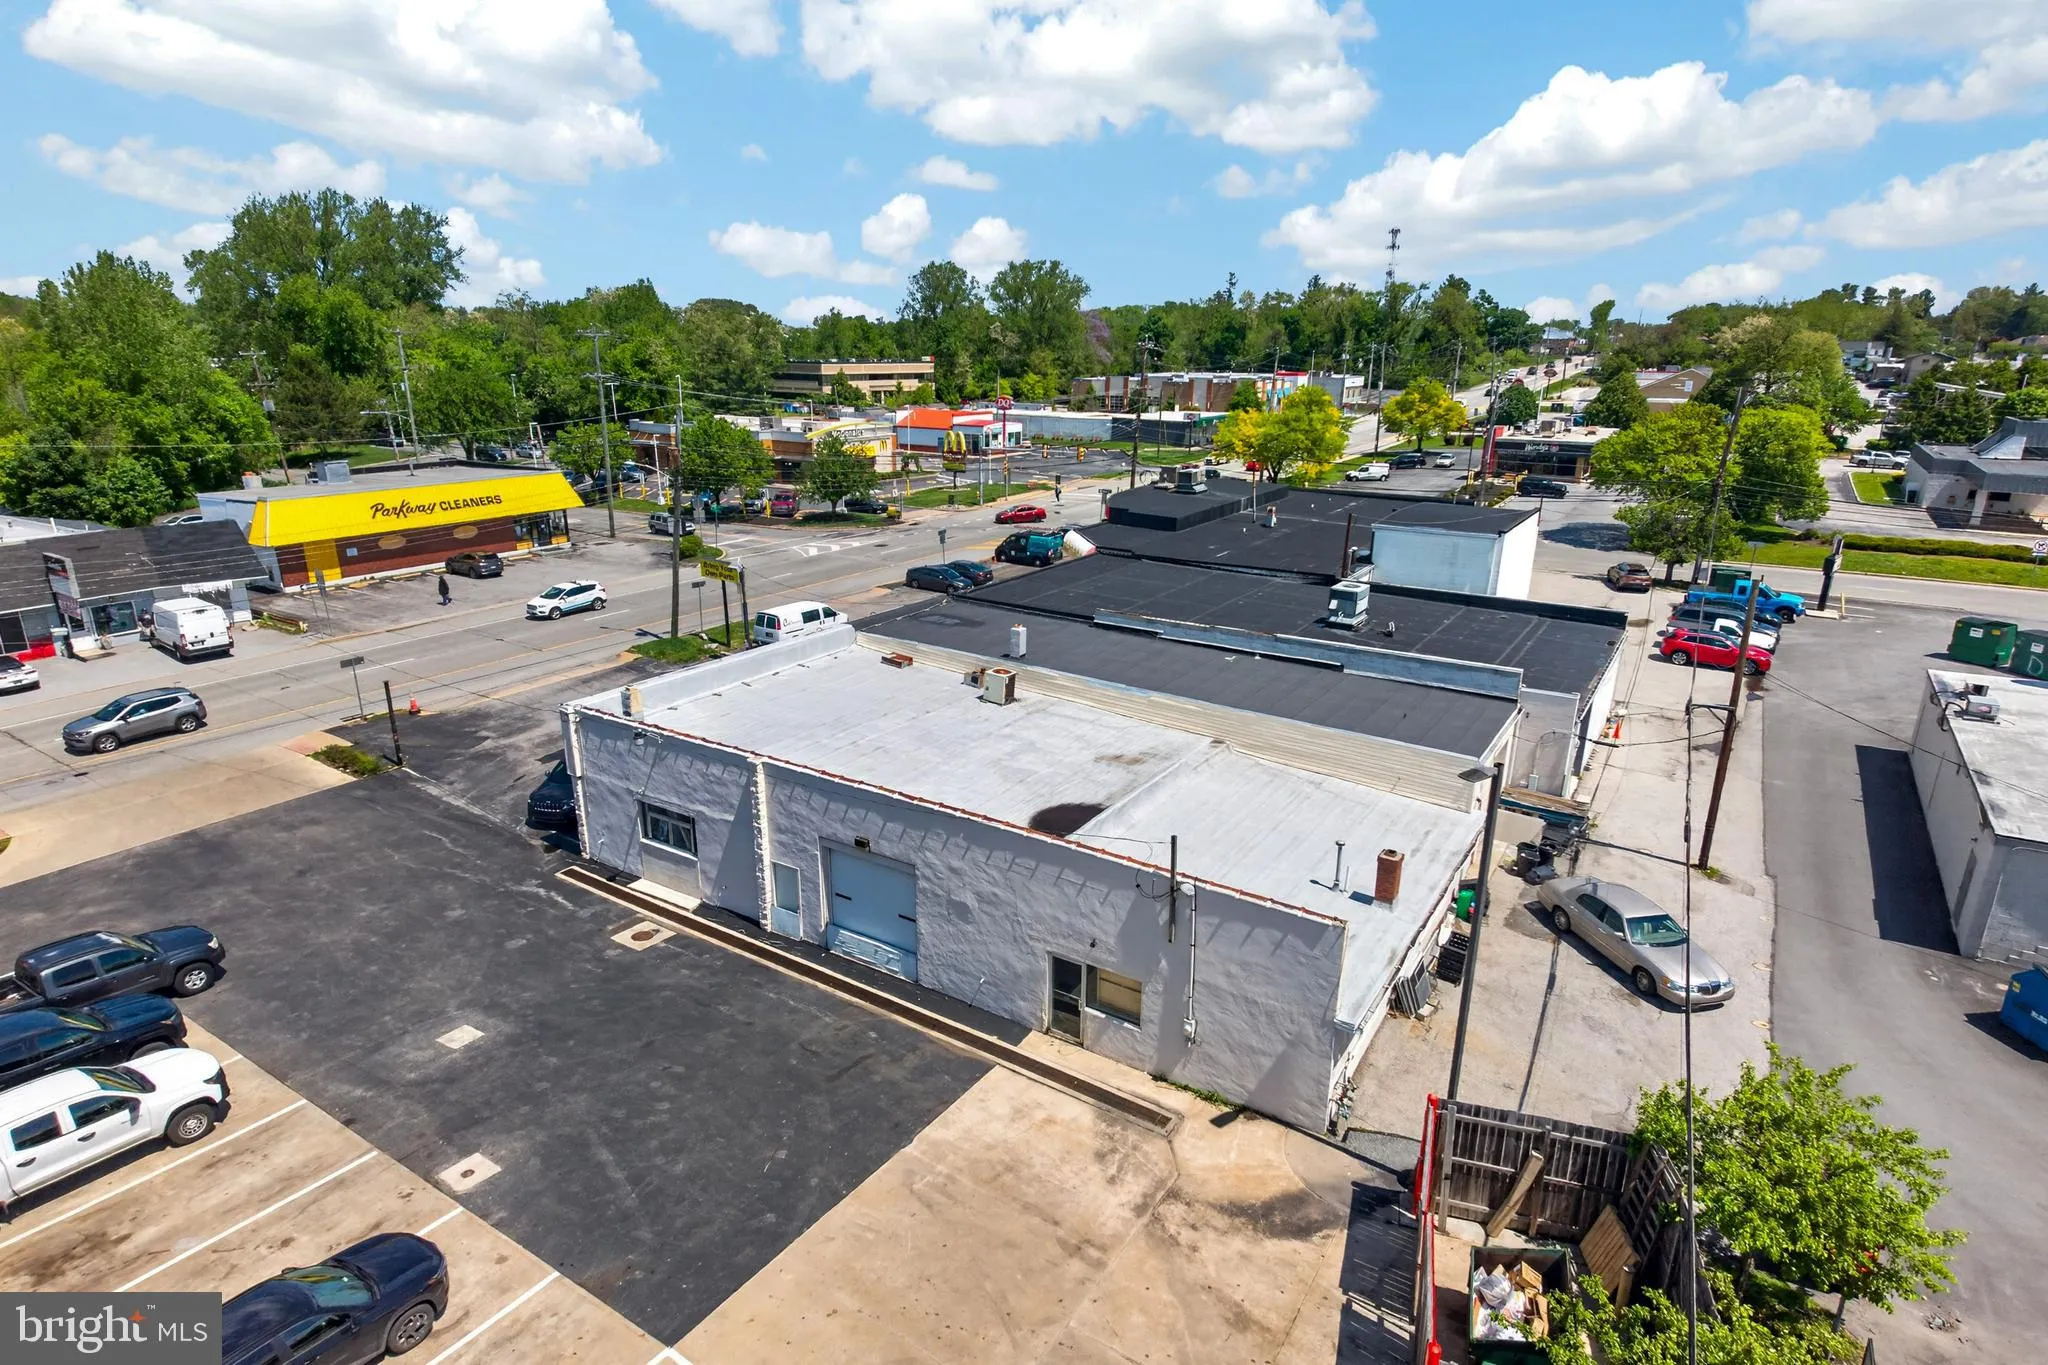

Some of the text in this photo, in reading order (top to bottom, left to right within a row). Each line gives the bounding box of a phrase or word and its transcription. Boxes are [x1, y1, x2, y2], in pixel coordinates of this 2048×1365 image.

[998, 398, 1010, 409] DQ
[370, 495, 503, 519] Parkway CLEANERS
